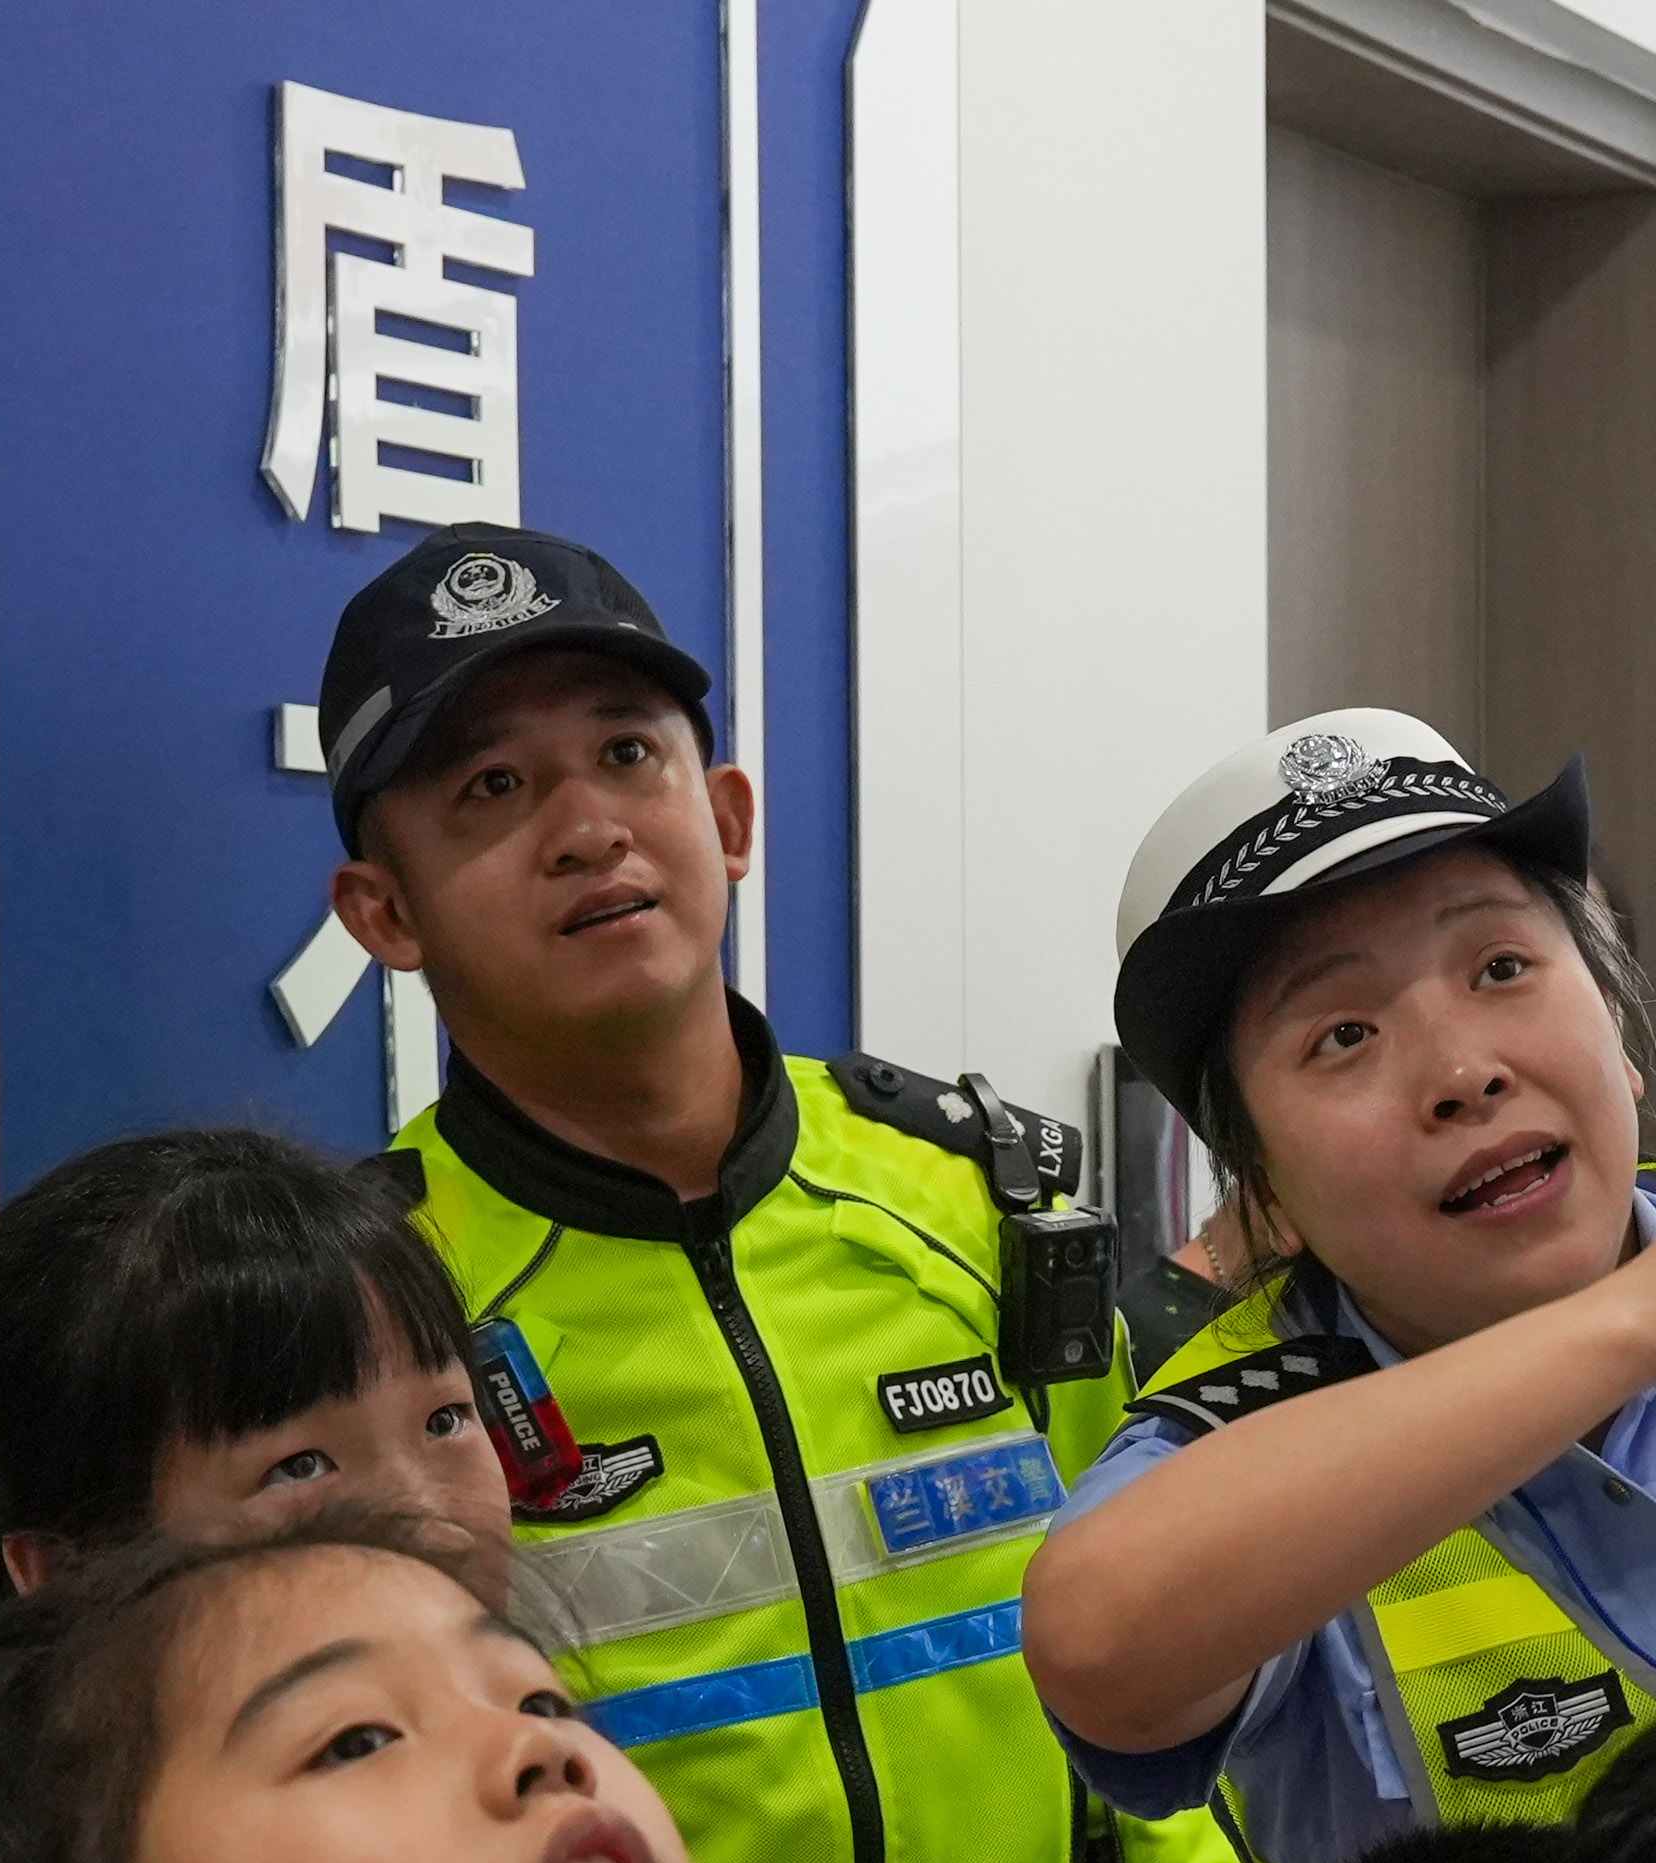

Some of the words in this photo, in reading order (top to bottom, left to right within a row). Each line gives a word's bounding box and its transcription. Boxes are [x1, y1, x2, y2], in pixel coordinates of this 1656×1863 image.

[488, 1371, 542, 1451] POLICE
[885, 1368, 996, 1421] FJ0870
[1512, 1716, 1559, 1742] POLICE
